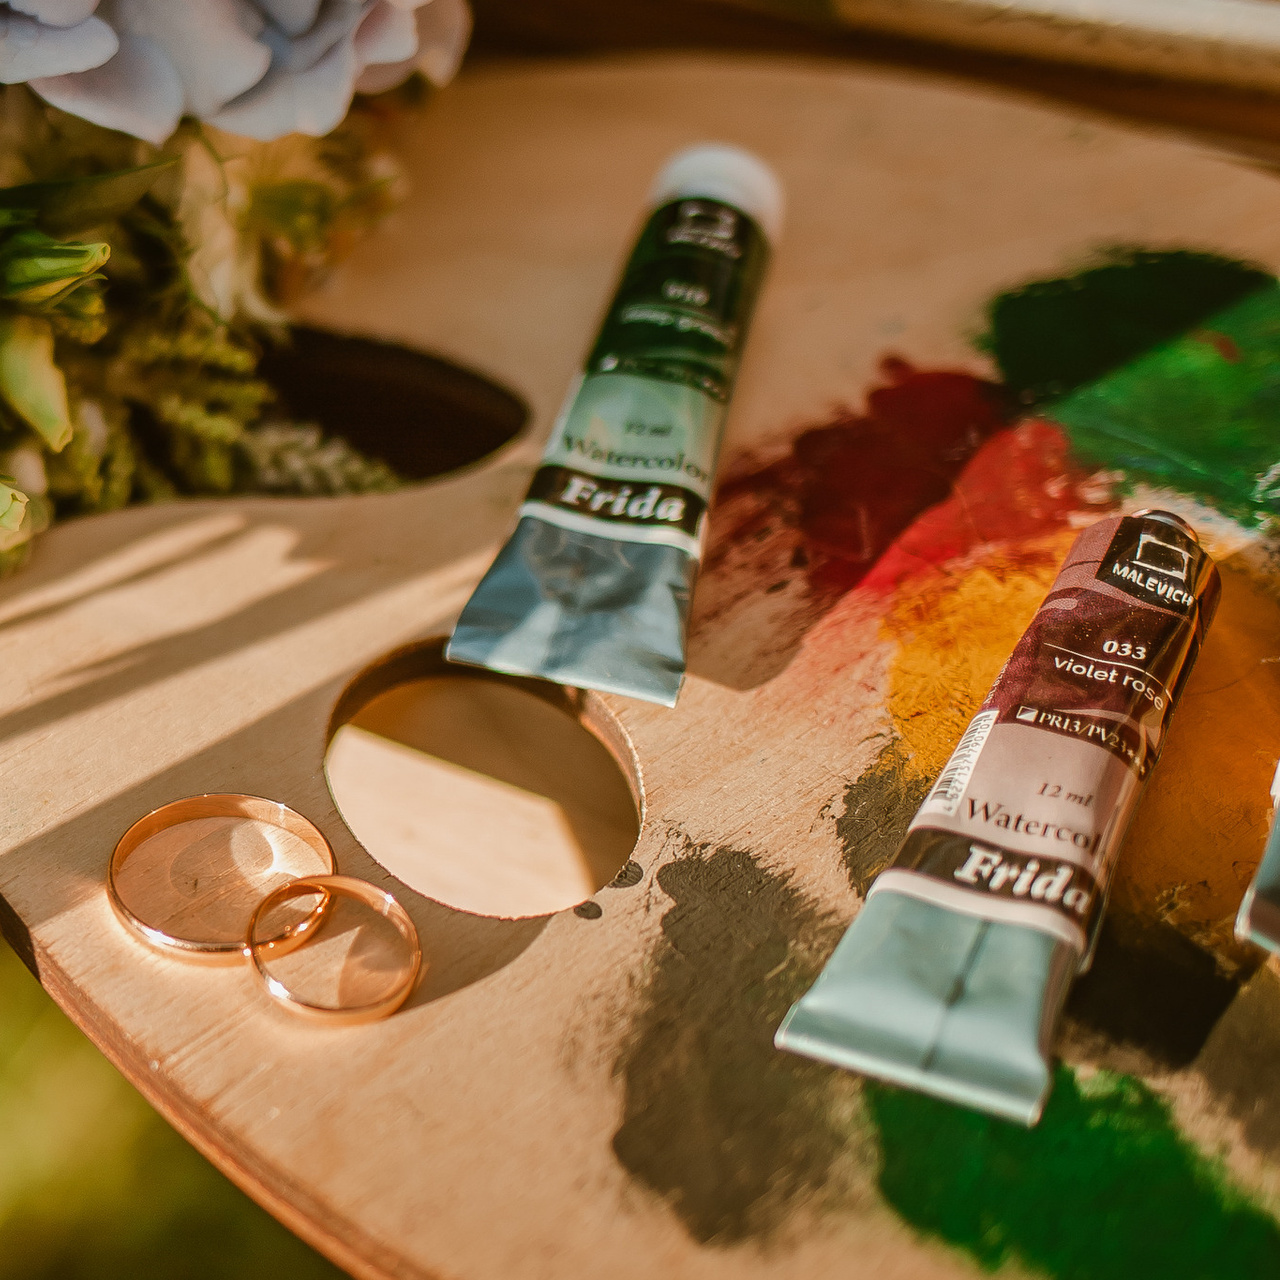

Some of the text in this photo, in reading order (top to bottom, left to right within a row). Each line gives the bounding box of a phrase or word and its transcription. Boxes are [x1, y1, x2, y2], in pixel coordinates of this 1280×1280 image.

[563, 430, 708, 482] Watercolor
[560, 475, 686, 522] Frida
[1112, 562, 1195, 607] MALEVICH
[1102, 639, 1147, 661] 033
[1054, 656, 1165, 711] violet rose
[1037, 782, 1095, 808] 12 ml
[967, 797, 1102, 856] Watercol
[953, 844, 1091, 915] Frida
